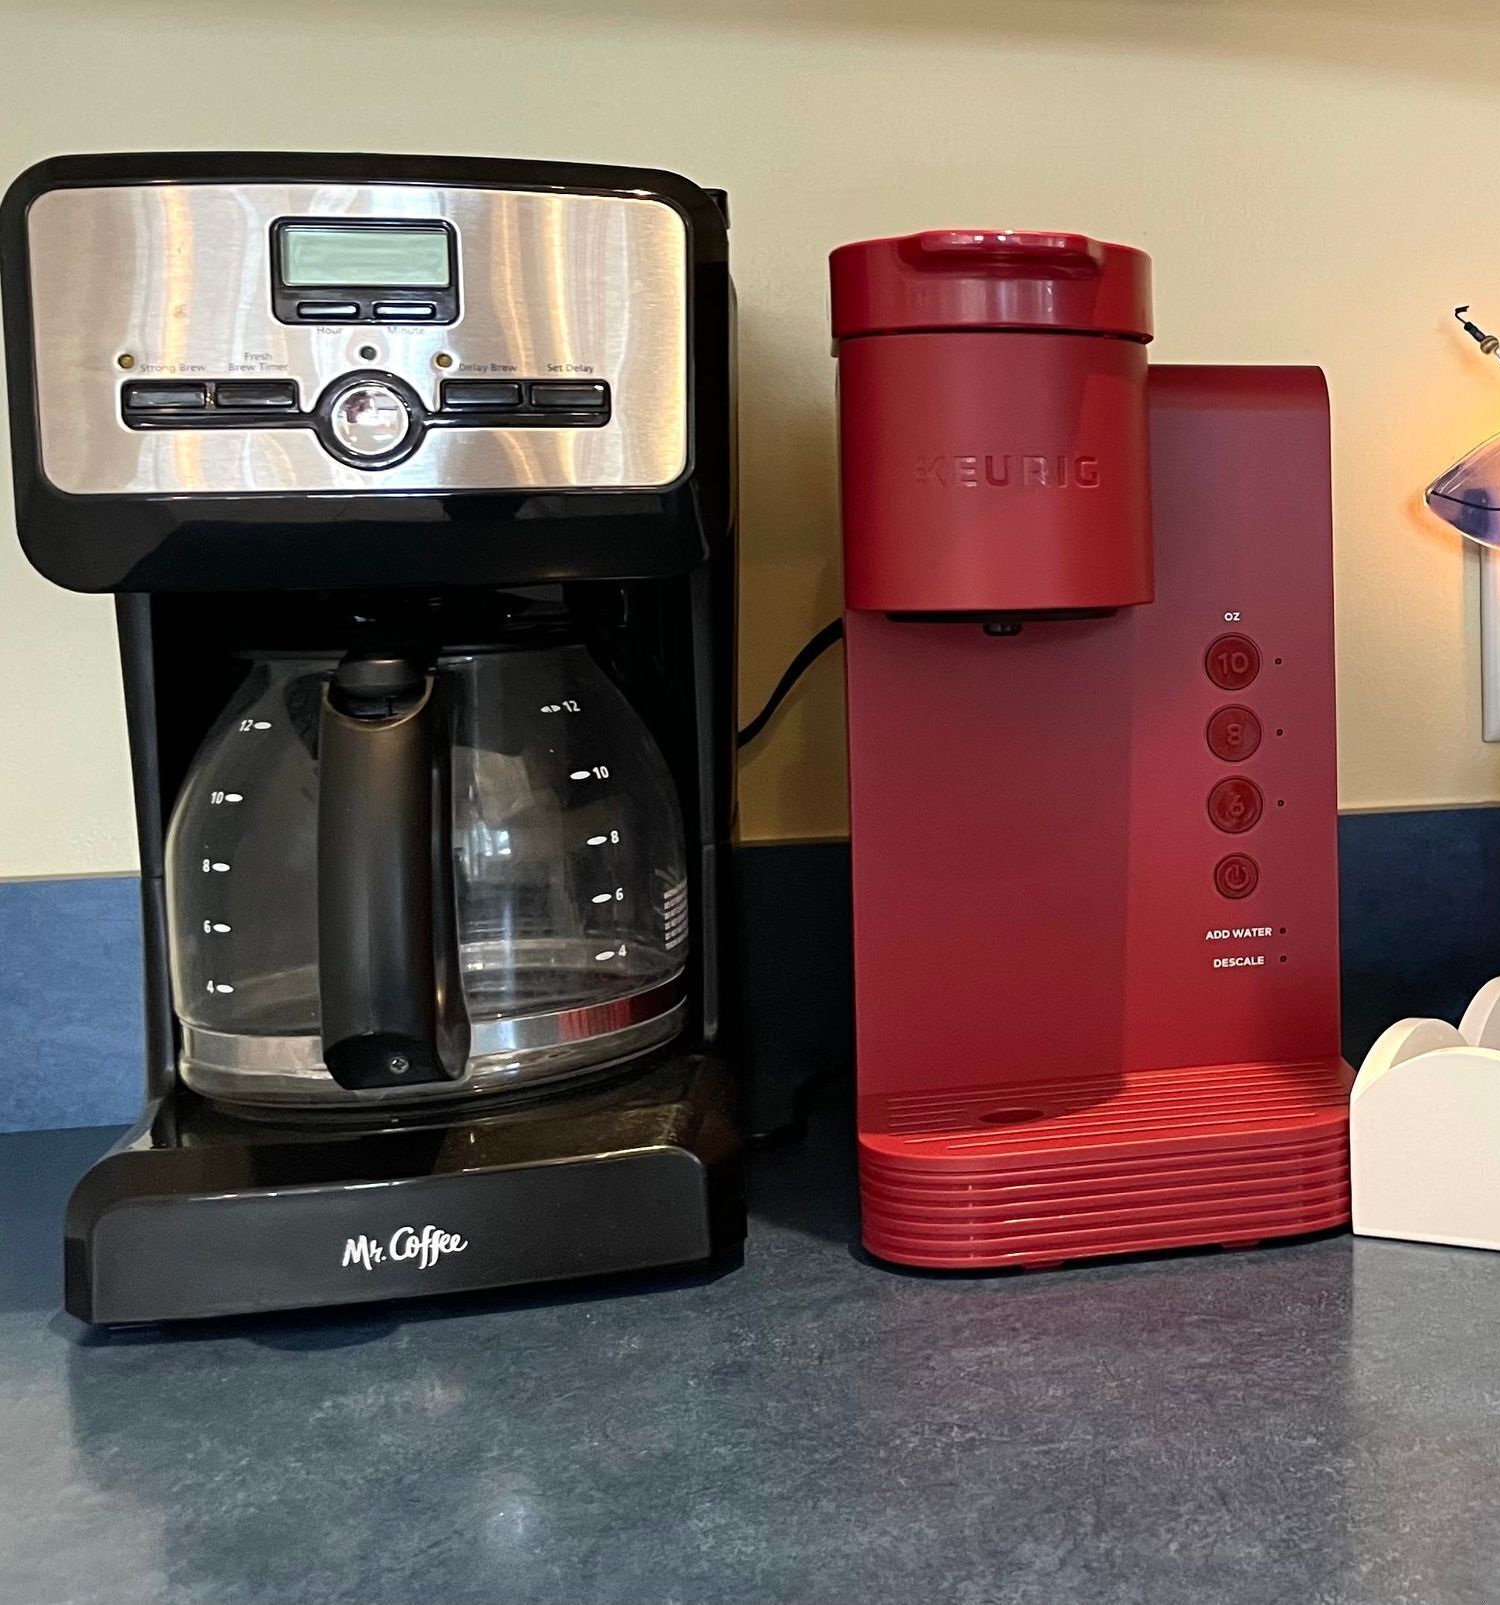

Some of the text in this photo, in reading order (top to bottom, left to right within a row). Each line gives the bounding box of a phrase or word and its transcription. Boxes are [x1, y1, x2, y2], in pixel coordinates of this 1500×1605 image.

[316, 326, 343, 335] Hour
[243, 351, 272, 361] Fresh
[139, 363, 206, 374] Strong Brew
[228, 362, 289, 372] Brew Timer
[458, 363, 517, 373] Delay Brew
[546, 363, 594, 374] Set Delay
[914, 454, 1100, 488] KEURIG
[1224, 612, 1241, 622] OZ
[1217, 651, 1249, 675] 10
[562, 700, 581, 712] 12
[239, 719, 254, 732] 12
[1226, 723, 1243, 746] 8
[592, 765, 609, 780] 10
[210, 791, 224, 805] 10
[1228, 793, 1245, 817] 6
[610, 830, 620, 844] 8
[202, 858, 211, 873] 8
[615, 887, 624, 901] 6
[203, 920, 211, 934] 6
[1205, 927, 1273, 940] ADD WATER
[618, 944, 627, 957] 4
[1213, 956, 1265, 968] DESCALE
[206, 980, 215, 994] 4
[341, 1224, 469, 1271] Mr. Coffee
